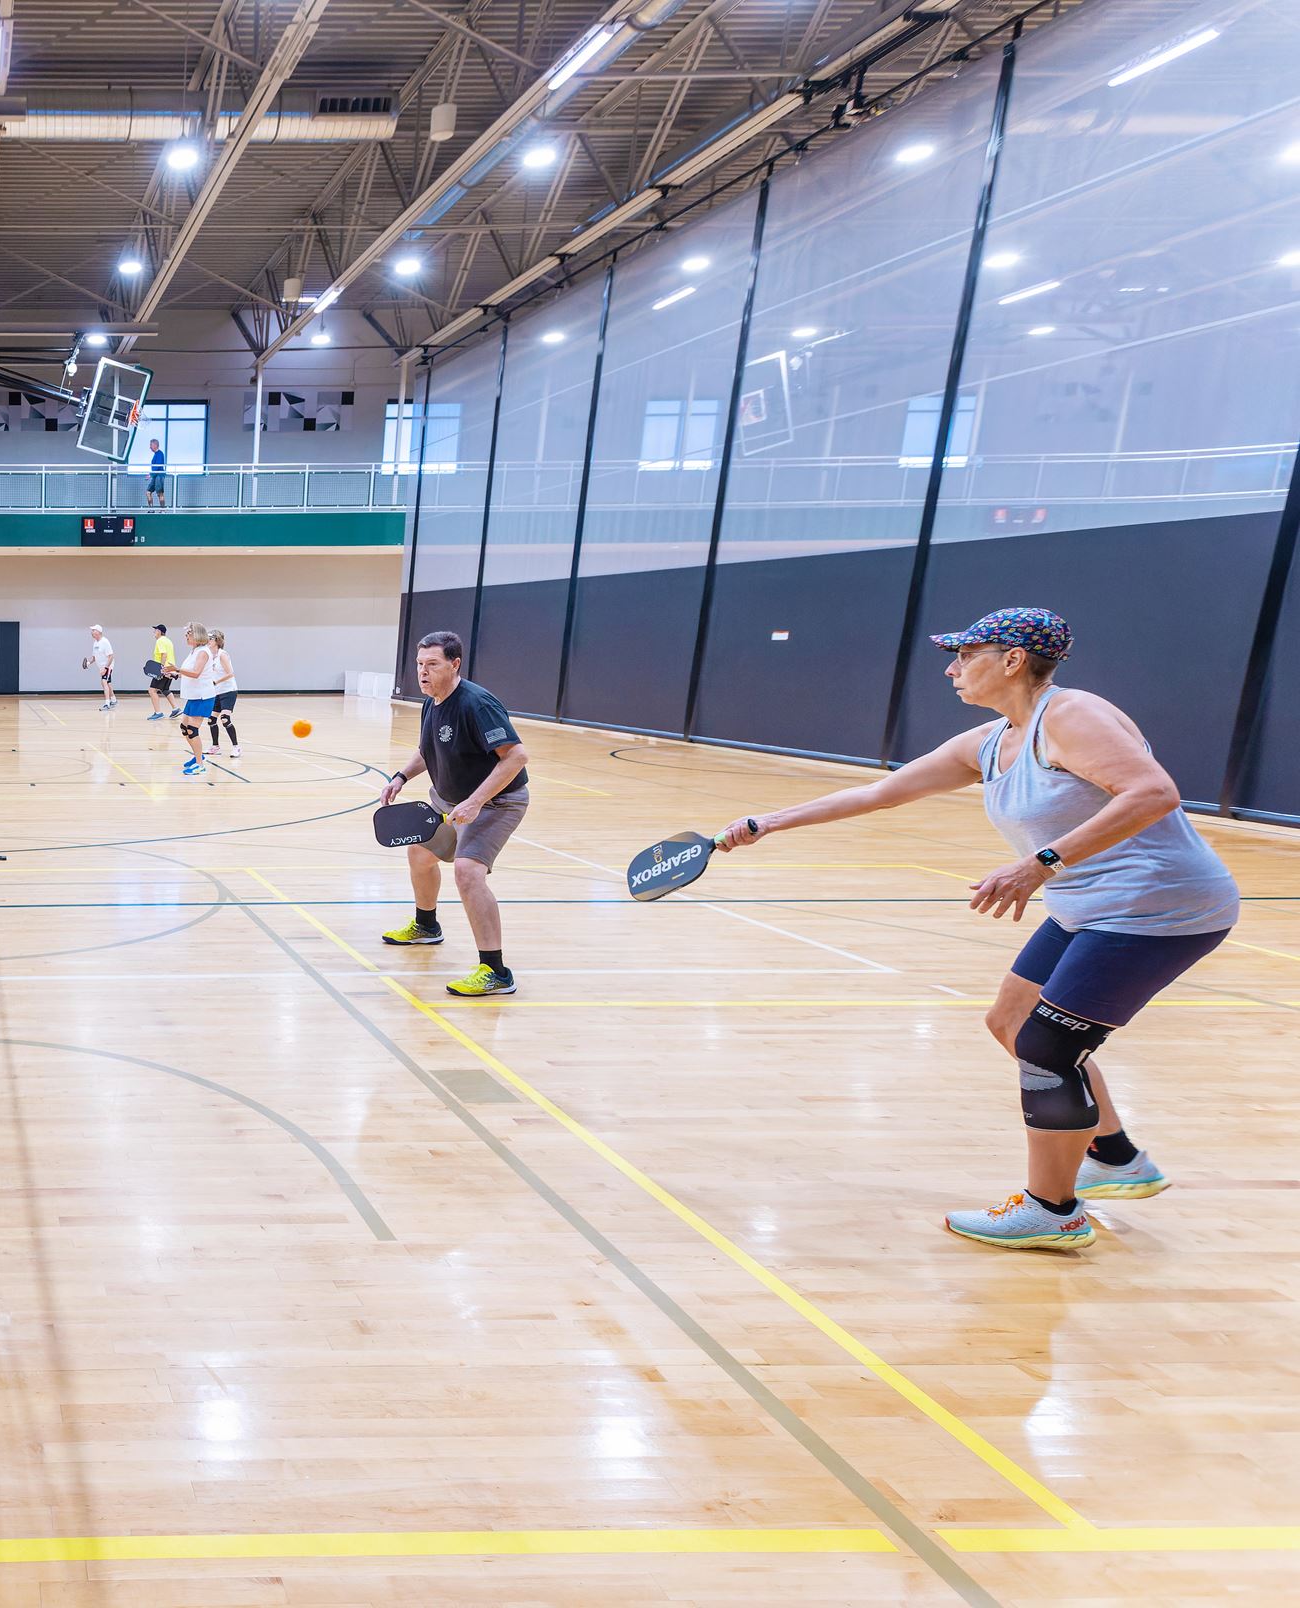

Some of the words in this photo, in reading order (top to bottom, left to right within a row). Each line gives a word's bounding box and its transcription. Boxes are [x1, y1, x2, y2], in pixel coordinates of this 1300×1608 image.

[390, 834, 422, 846] LEGACY
[631, 844, 702, 888] GEARBOX
[1050, 1011, 1092, 1031] cep
[1060, 1215, 1087, 1232] HOKA
